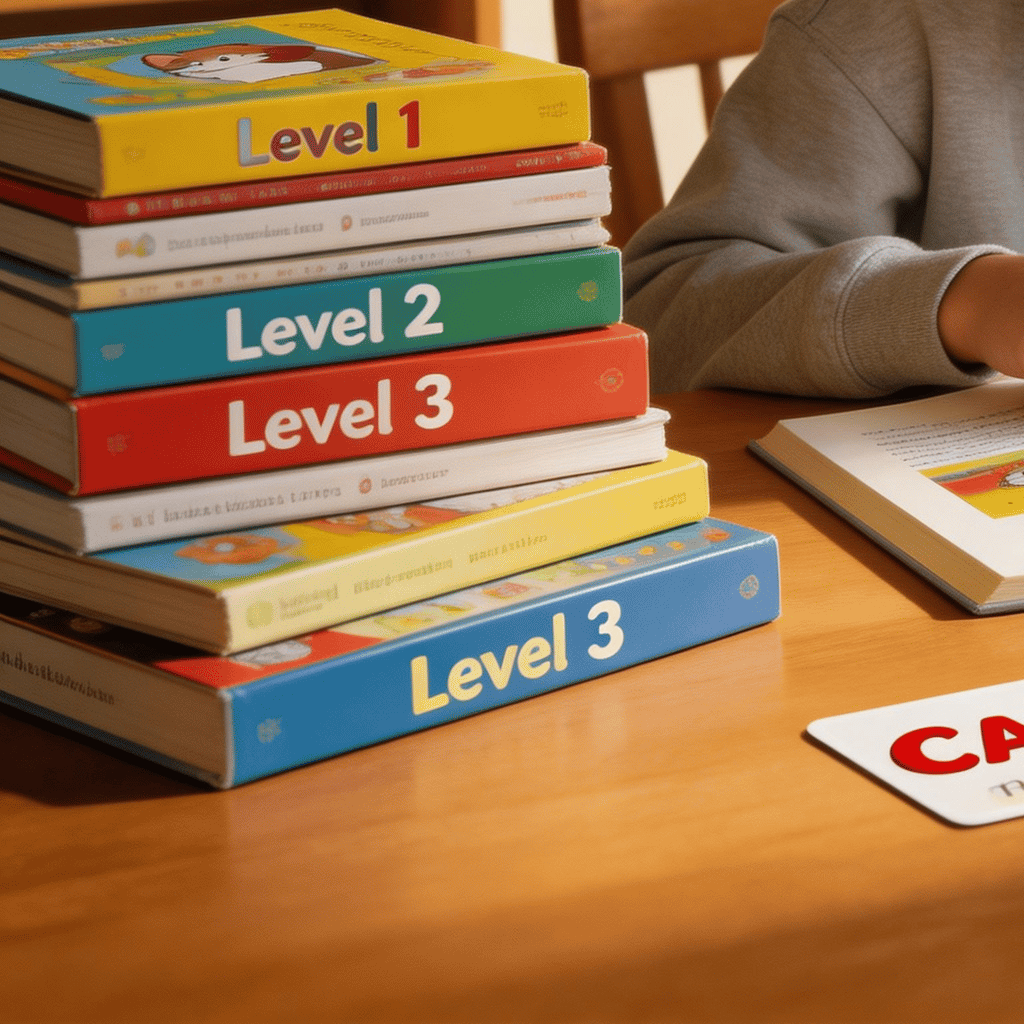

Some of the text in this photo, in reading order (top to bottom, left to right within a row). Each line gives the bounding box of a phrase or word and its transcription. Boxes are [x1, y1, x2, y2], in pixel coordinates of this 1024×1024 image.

[237, 100, 421, 167] Level 1
[226, 283, 444, 362] Level 2
[228, 373, 454, 457] Level 3
[410, 599, 625, 716] Level 3
